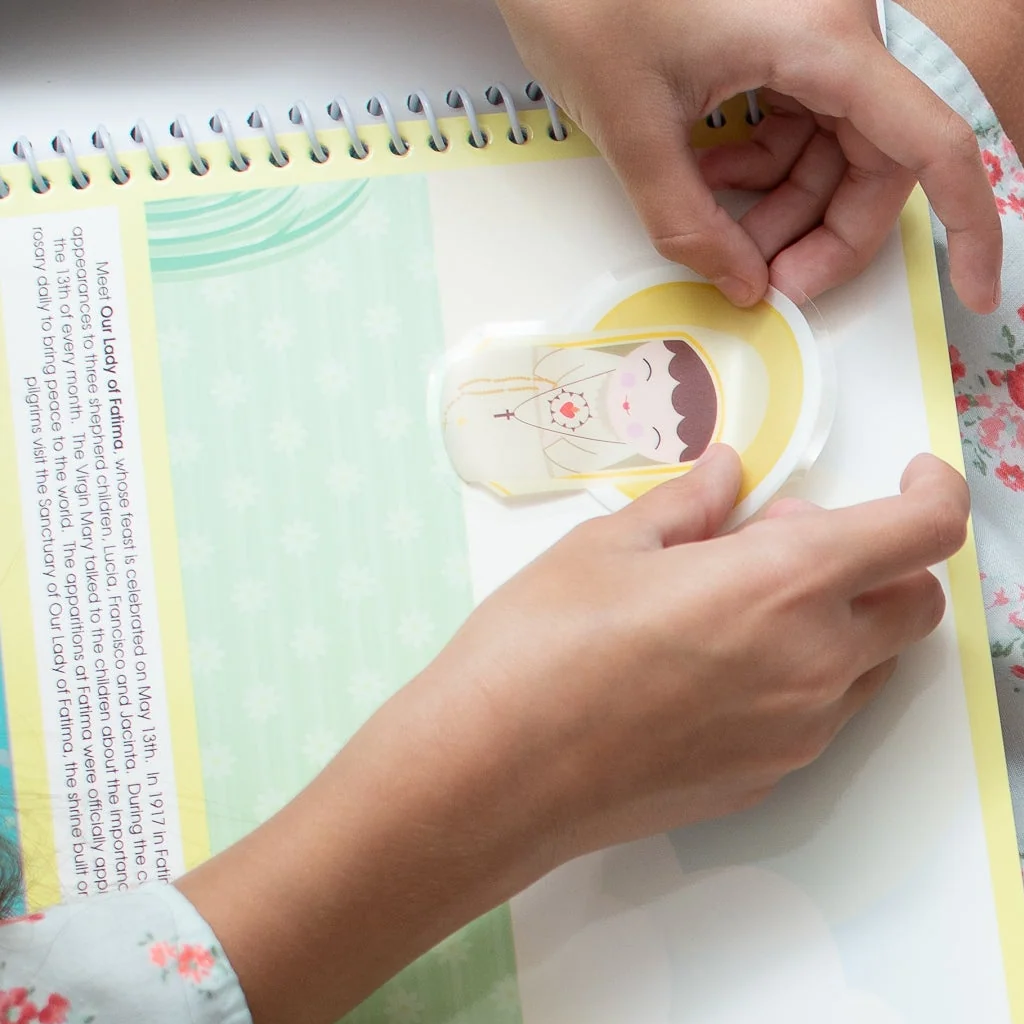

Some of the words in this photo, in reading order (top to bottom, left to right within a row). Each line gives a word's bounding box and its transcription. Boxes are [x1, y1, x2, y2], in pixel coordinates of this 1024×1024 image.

[33, 227, 46, 271] rosary
[54, 238, 66, 262] the
[37, 276, 52, 311] daily
[57, 269, 71, 299] 13th
[70, 226, 92, 330] appearances
[96, 262, 111, 300] Meet
[41, 316, 54, 332] to
[60, 304, 74, 319] of
[100, 306, 113, 333] Our
[42, 336, 57, 375] bring
[62, 324, 75, 365] every
[83, 334, 95, 349] to
[103, 338, 118, 374] Lady
[84, 354, 98, 393] three
[107, 379, 121, 393] of
[24, 377, 43, 434] pilgrims
[44, 380, 62, 431] peace
[66, 370, 83, 424] month.
[52, 436, 66, 452] to
[88, 398, 108, 470] shepherd
[109, 398, 125, 454] Fatima,
[33, 438, 48, 464] visit
[72, 432, 86, 460] The
[36, 468, 49, 494] the
[54, 456, 68, 481] the
[74, 464, 91, 506] Virgin
[114, 458, 129, 508] whose
[58, 486, 74, 532] world.
[96, 475, 112, 541] children,
[38, 499, 56, 578] Sanctuary
[80, 512, 94, 550] Mary
[120, 512, 136, 550] feast
[63, 541, 76, 568] The
[104, 546, 119, 591] Lucia,
[124, 555, 137, 564] is
[47, 583, 61, 598] of
[84, 555, 102, 603] talked
[49, 603, 62, 631] Our
[64, 574, 84, 661] apparitions
[90, 608, 103, 623] to
[126, 569, 147, 656] celebrated
[92, 628, 105, 653] the
[108, 596, 126, 670] Francisco
[52, 636, 68, 674] Lady
[75, 666, 90, 681] at
[135, 661, 147, 681] on
[56, 679, 71, 694] of
[94, 658, 111, 721] children
[116, 674, 132, 706] and
[137, 686, 152, 720] May
[58, 699, 74, 757] Fatima,
[77, 686, 93, 740] Fatima
[101, 726, 119, 774] about
[120, 711, 138, 773] Jacinta.
[142, 727, 157, 762] 13th.
[64, 762, 78, 788] the
[83, 744, 96, 784] were
[146, 772, 160, 786] In
[107, 778, 120, 806] the
[127, 784, 143, 835] During
[149, 792, 165, 825] 1917
[68, 793, 84, 838] shrine
[88, 788, 106, 852] officially
[110, 808, 128, 891] importanc
[133, 839, 147, 867] the
[153, 831, 166, 844] in
[73, 842, 89, 876] built
